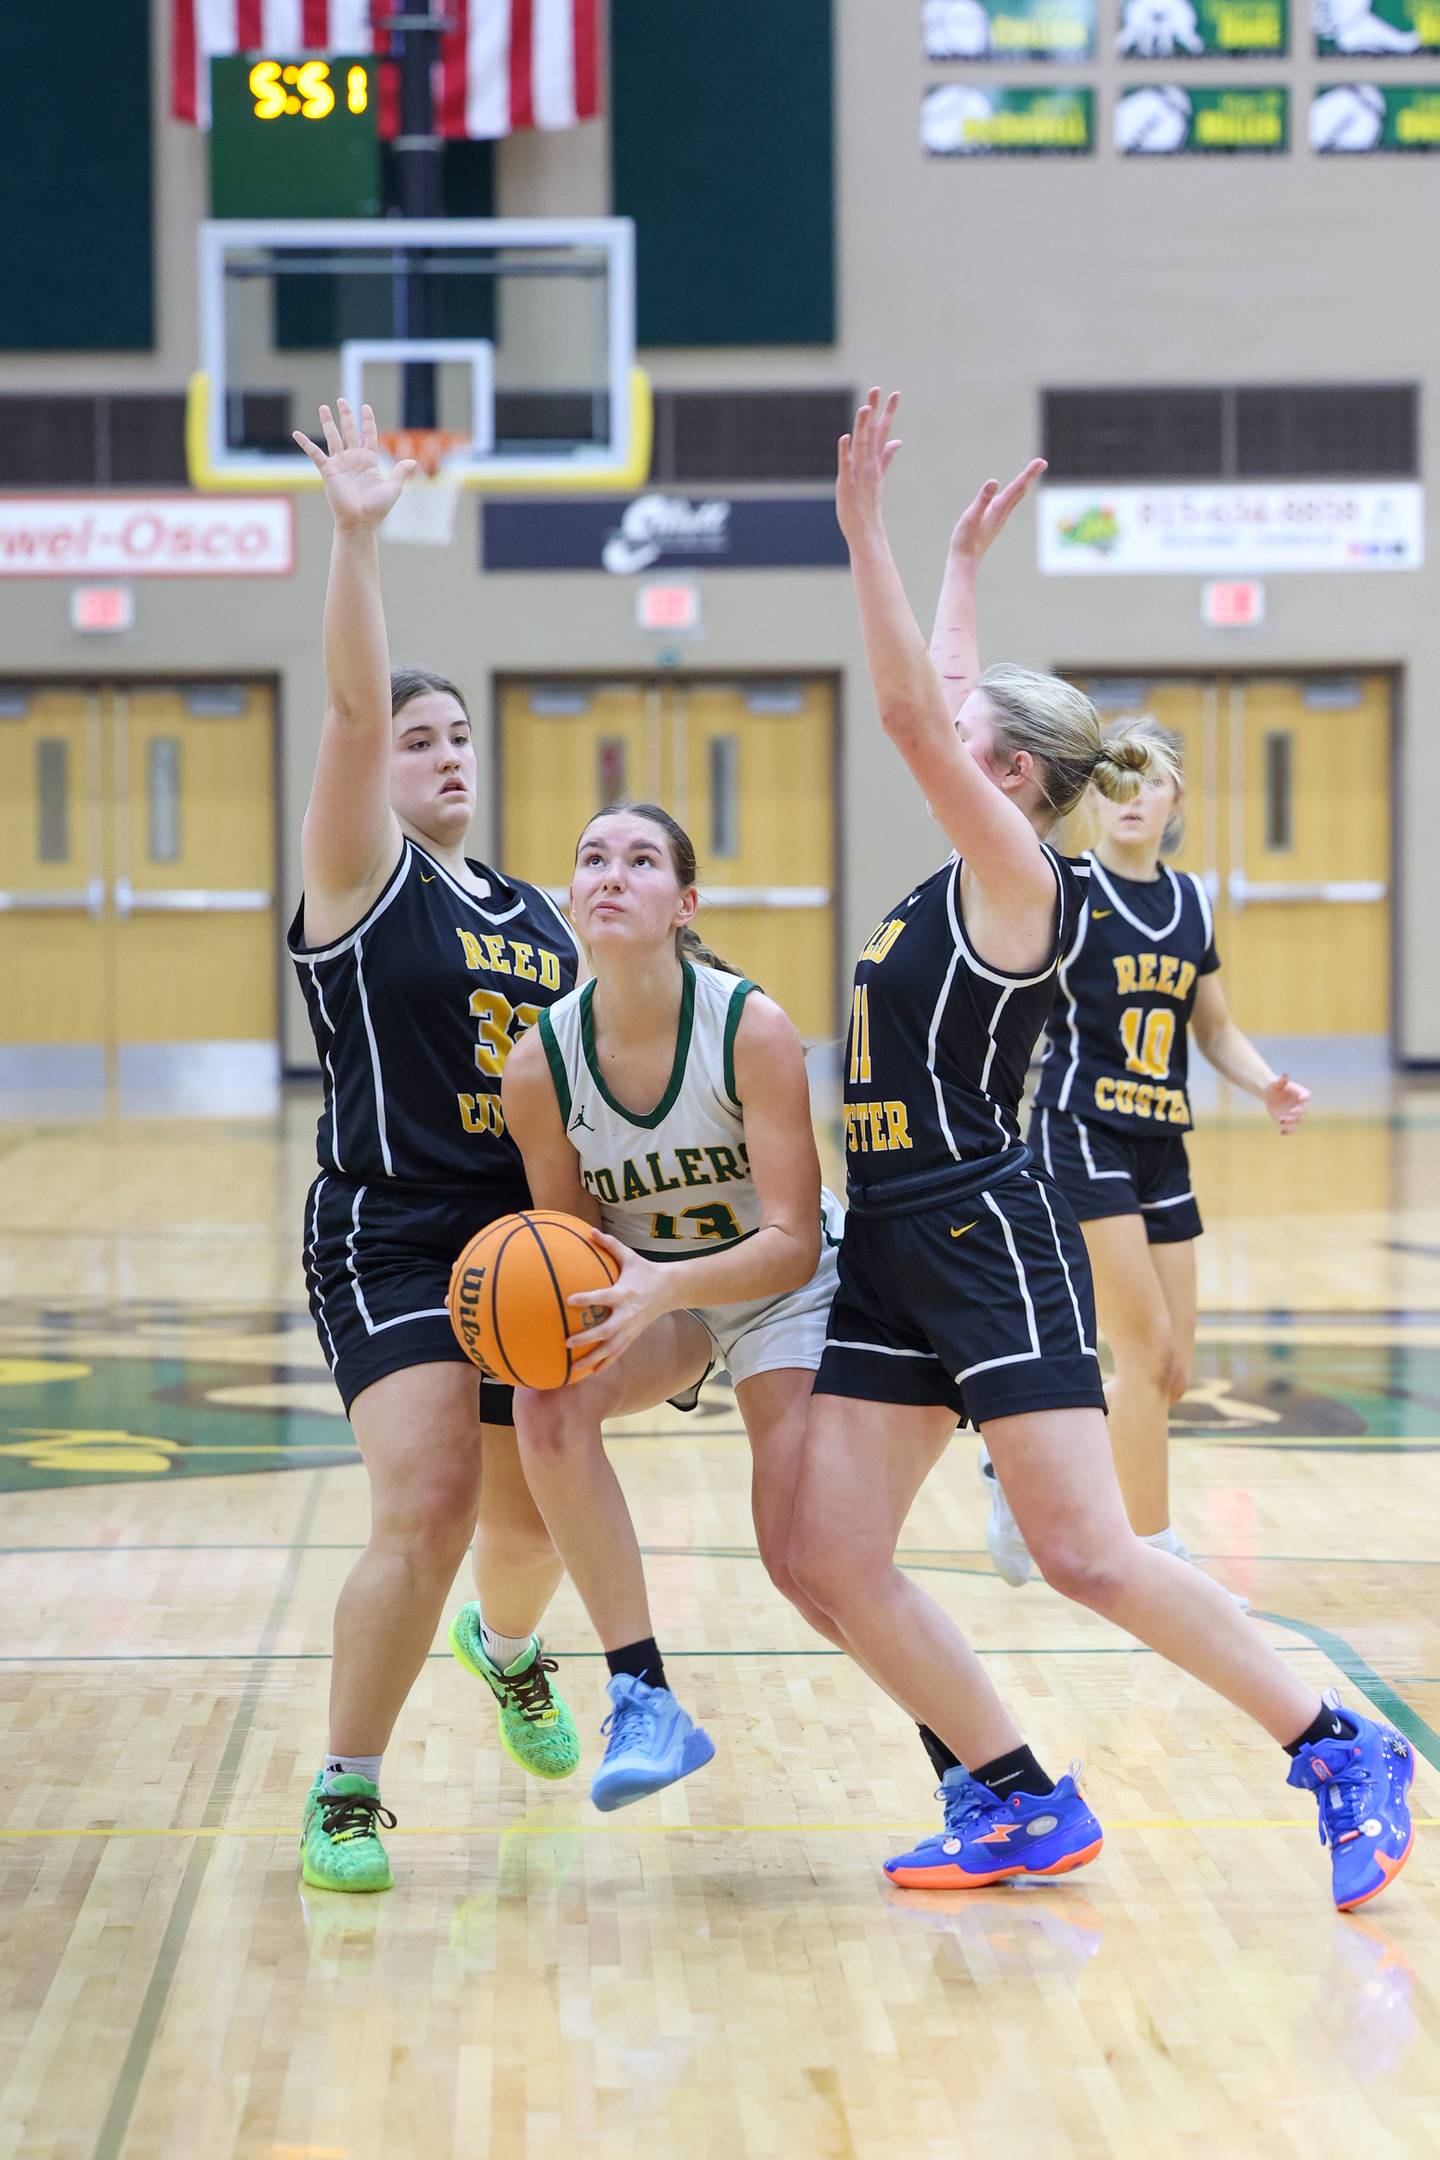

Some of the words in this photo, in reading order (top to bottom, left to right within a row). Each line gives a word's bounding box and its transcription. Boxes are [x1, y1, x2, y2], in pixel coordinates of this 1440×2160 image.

[249, 61, 368, 120] 5:51
[456, 927, 560, 992] REED
[1113, 953, 1197, 1001] REED
[850, 984, 872, 1084] 11
[1119, 1007, 1175, 1080] 10
[843, 1101, 913, 1152] STER
